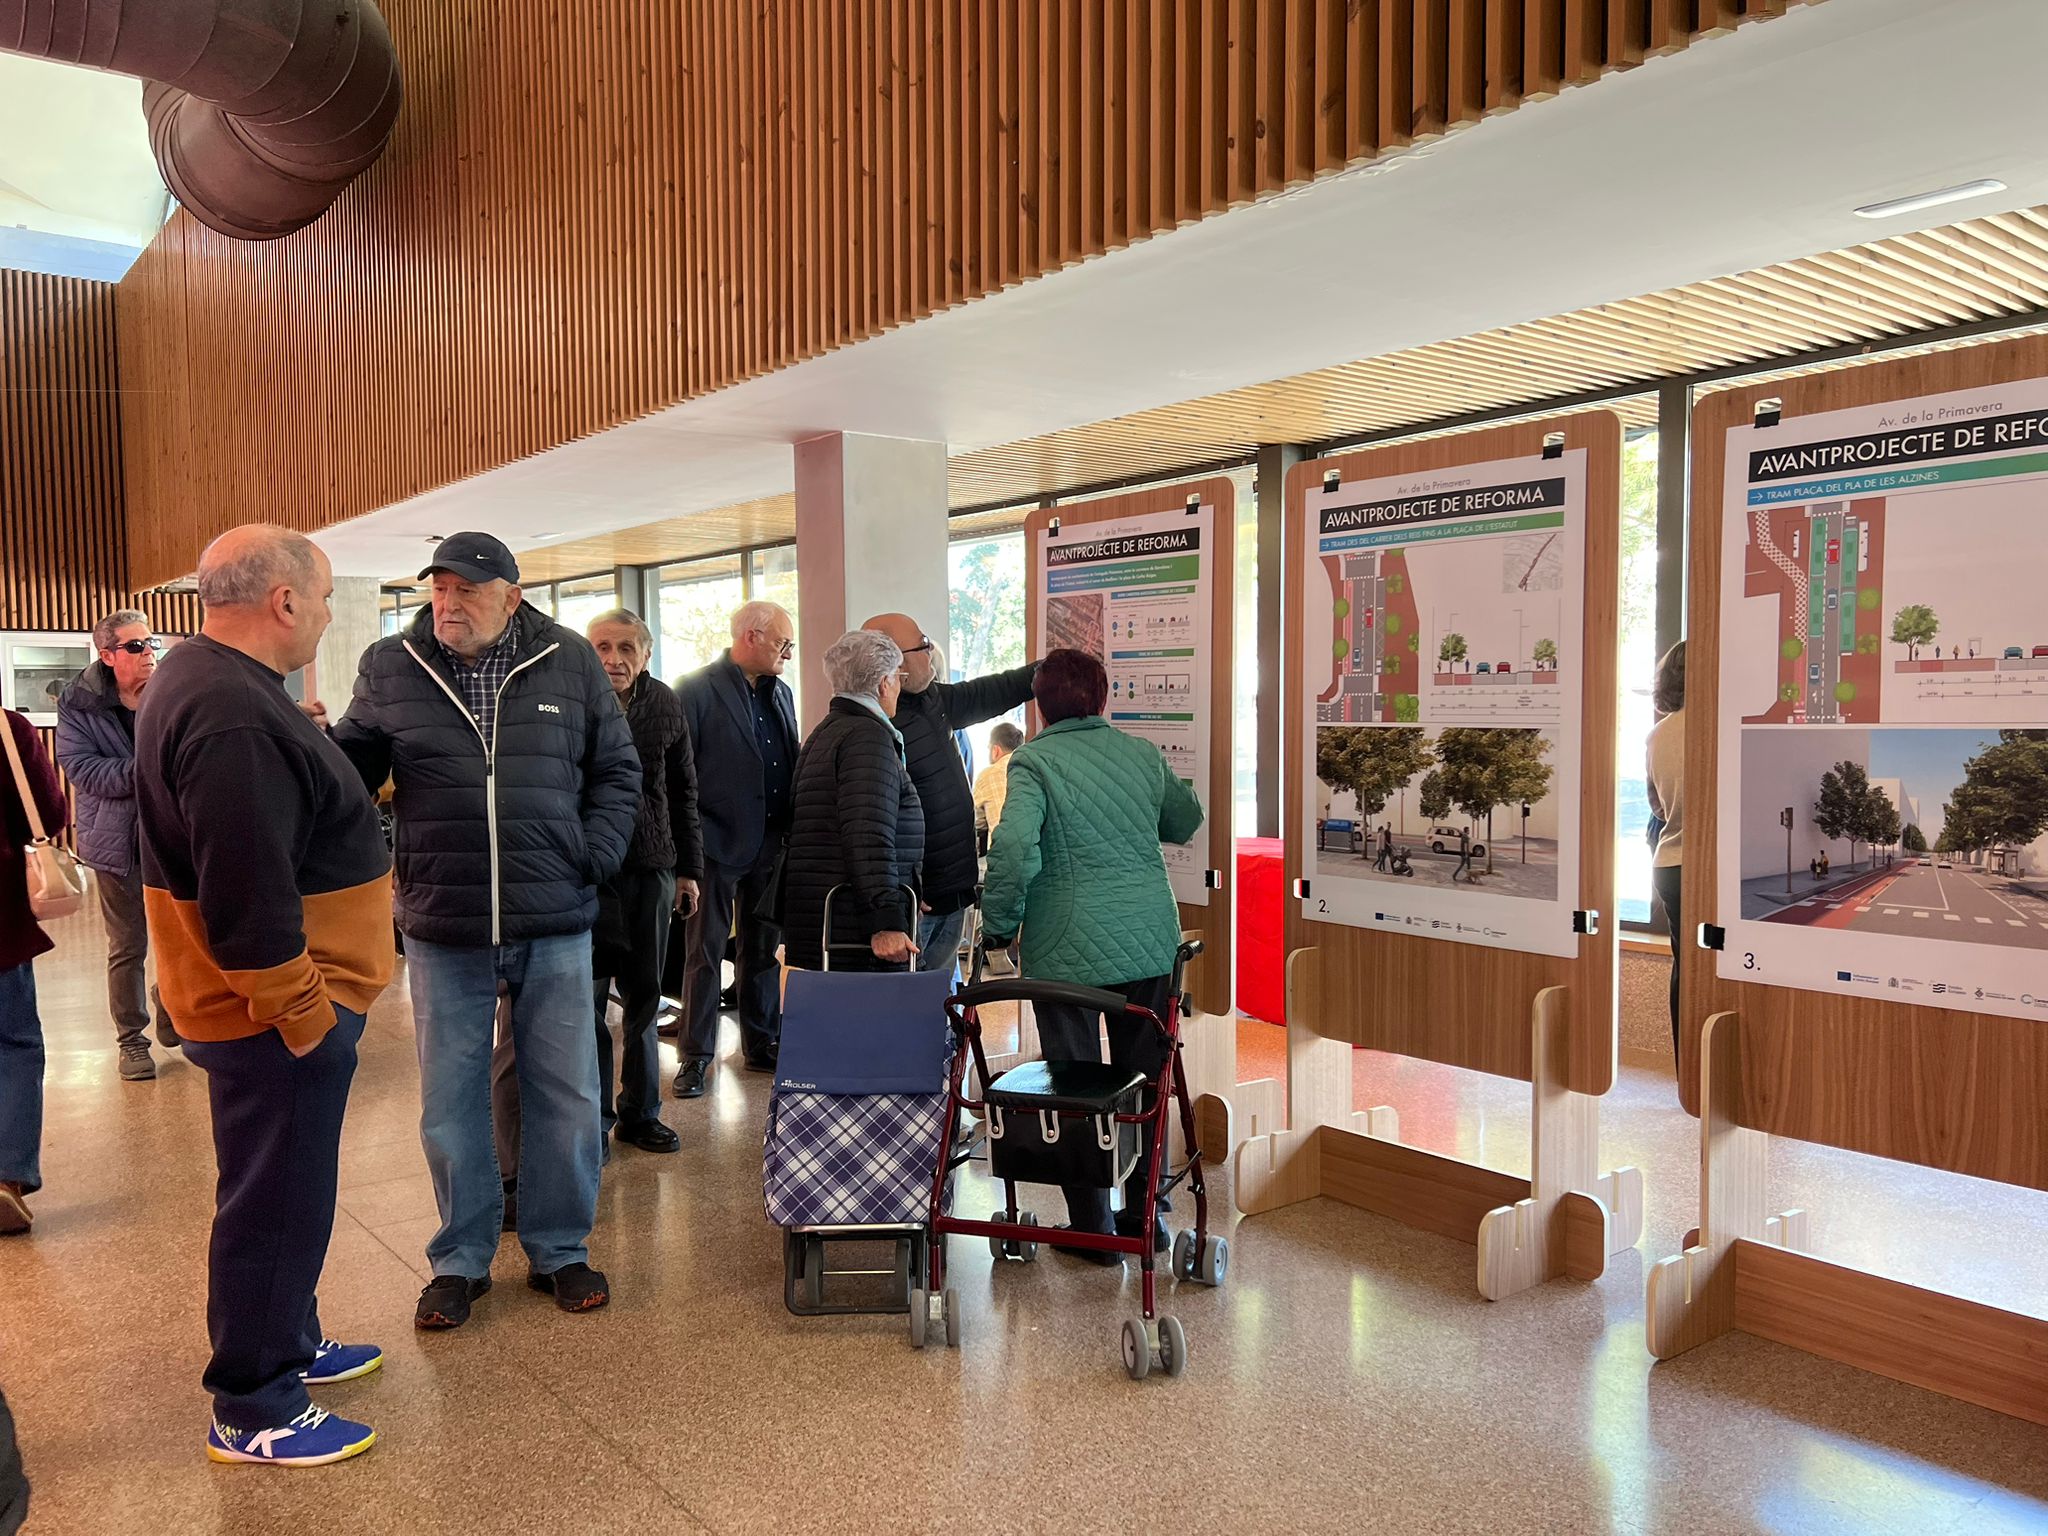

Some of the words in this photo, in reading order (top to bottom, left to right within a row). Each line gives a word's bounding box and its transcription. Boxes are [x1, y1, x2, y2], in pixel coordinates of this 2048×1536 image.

[1878, 416, 1898, 428] Av.
[1902, 413, 1917, 424] de
[1922, 410, 1934, 421] la
[1938, 401, 2003, 419] Primavera
[1757, 431, 1945, 475] AVANTPROJECTE
[1954, 426, 1986, 449] DE
[1397, 487, 1409, 495] Av.
[1411, 484, 1421, 493] de
[1423, 482, 1431, 491] la
[1432, 479, 1471, 491] Primavera
[1767, 490, 1792, 499] TRAM
[1825, 484, 1843, 493] DEL
[1844, 481, 1862, 491] PLA
[1863, 479, 1877, 488] DE
[1879, 476, 1895, 487] LES
[1898, 471, 1940, 484] ALZINES
[1325, 500, 1437, 528] AVANTPROJECTE
[1441, 496, 1461, 513] DE
[1465, 486, 1545, 511] REFORMA
[1050, 545, 1120, 562] AVANTPROJECTE
[1122, 541, 1135, 553] DE
[1137, 534, 1188, 551] REFORMA
[1330, 540, 1347, 548] TRAM
[538, 704, 560, 714] BOSS
[1318, 899, 1330, 914] 2.
[1743, 952, 1761, 970] 3.
